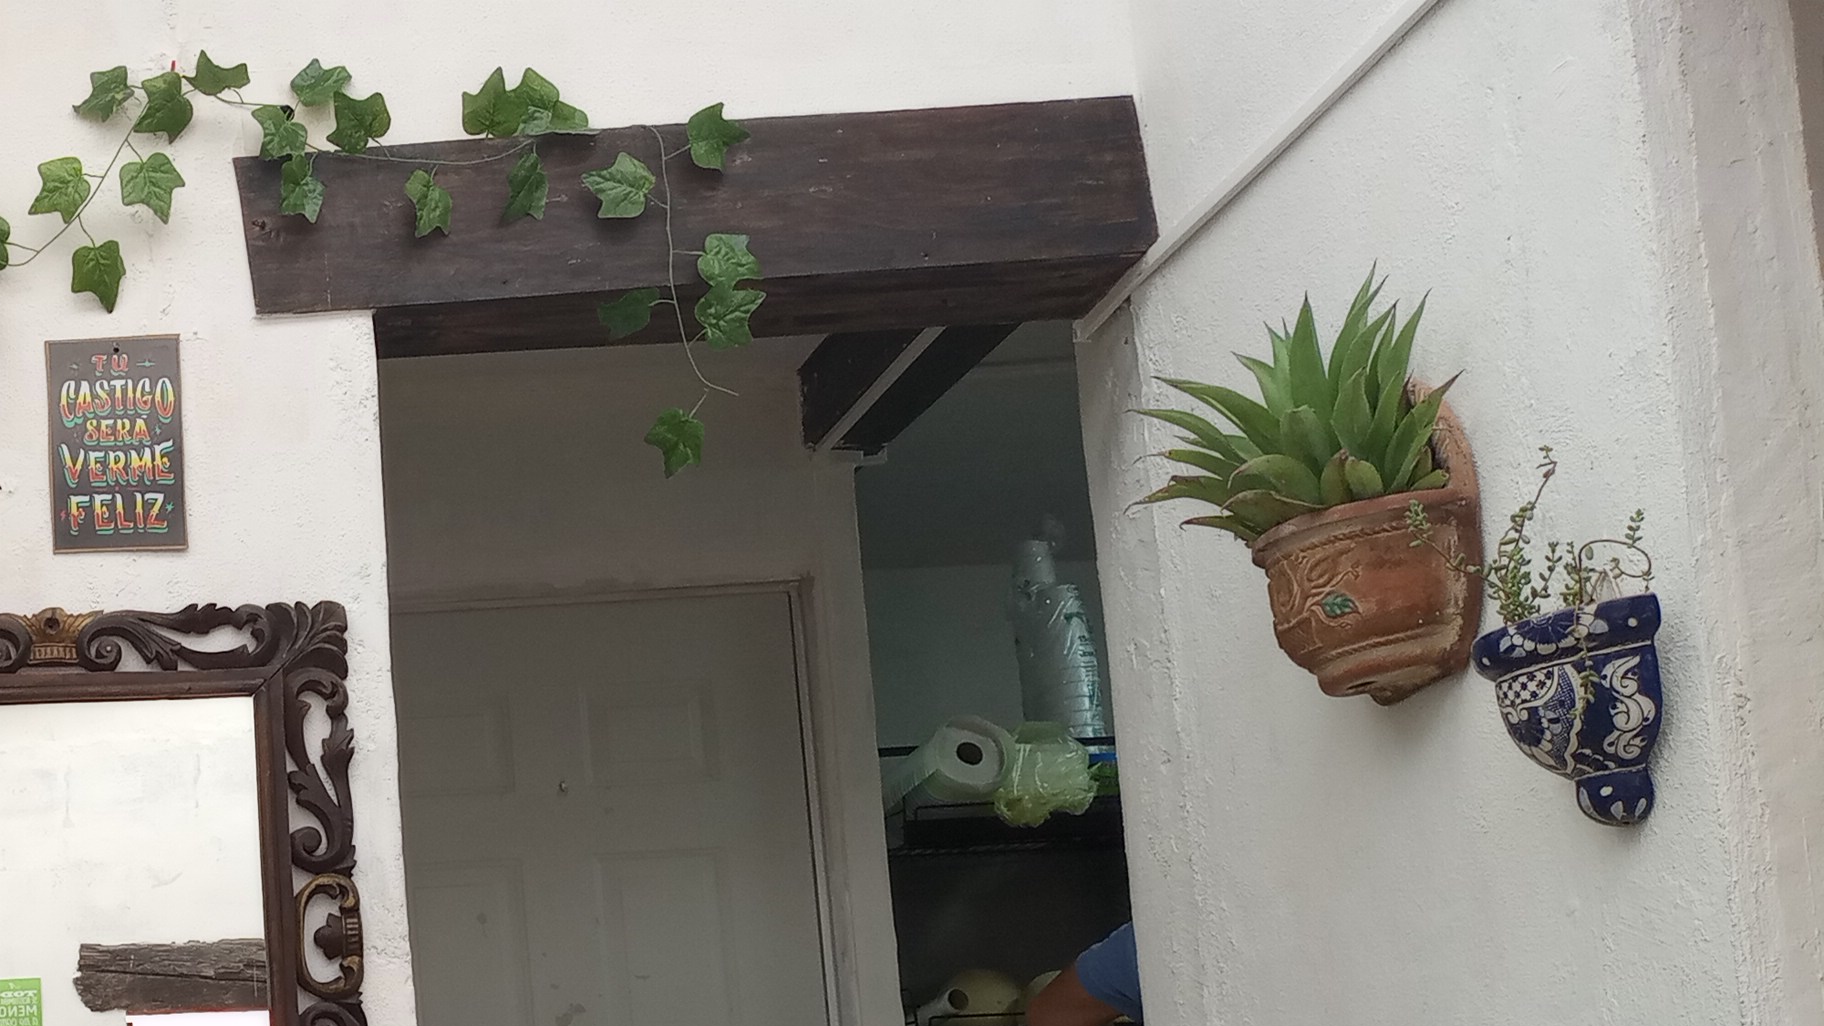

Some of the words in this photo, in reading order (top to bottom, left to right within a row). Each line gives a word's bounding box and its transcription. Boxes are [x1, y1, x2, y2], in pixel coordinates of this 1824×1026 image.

[91, 354, 129, 375] TU
[60, 377, 175, 426] CASTIGO
[58, 439, 175, 487] VERME
[68, 492, 168, 534] FELIZ
